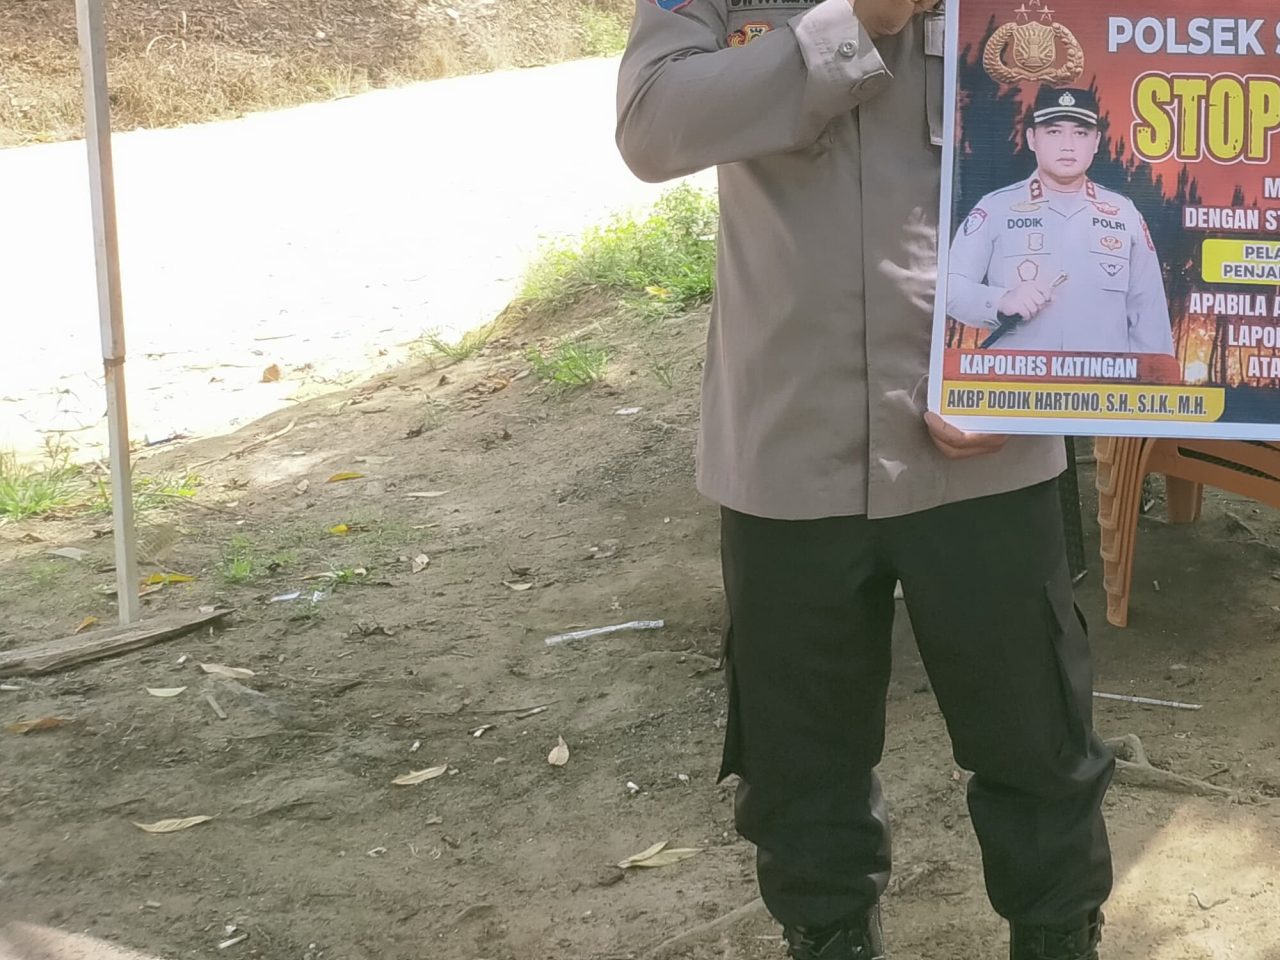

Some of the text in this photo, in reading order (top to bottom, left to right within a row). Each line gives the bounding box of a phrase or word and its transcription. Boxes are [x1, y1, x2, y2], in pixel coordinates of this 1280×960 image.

[1107, 16, 1263, 55] POLSEK
[1007, 218, 1043, 229] DODIK
[1092, 218, 1126, 231] POLRI
[1184, 207, 1260, 230] DENGAN
[1189, 293, 1267, 316] APABILA
[960, 354, 1137, 378] KAPOLRES KATINGAN
[947, 389, 1207, 416] AKBP DODIK HARTONO, S.H., S.I.K., M.H.
